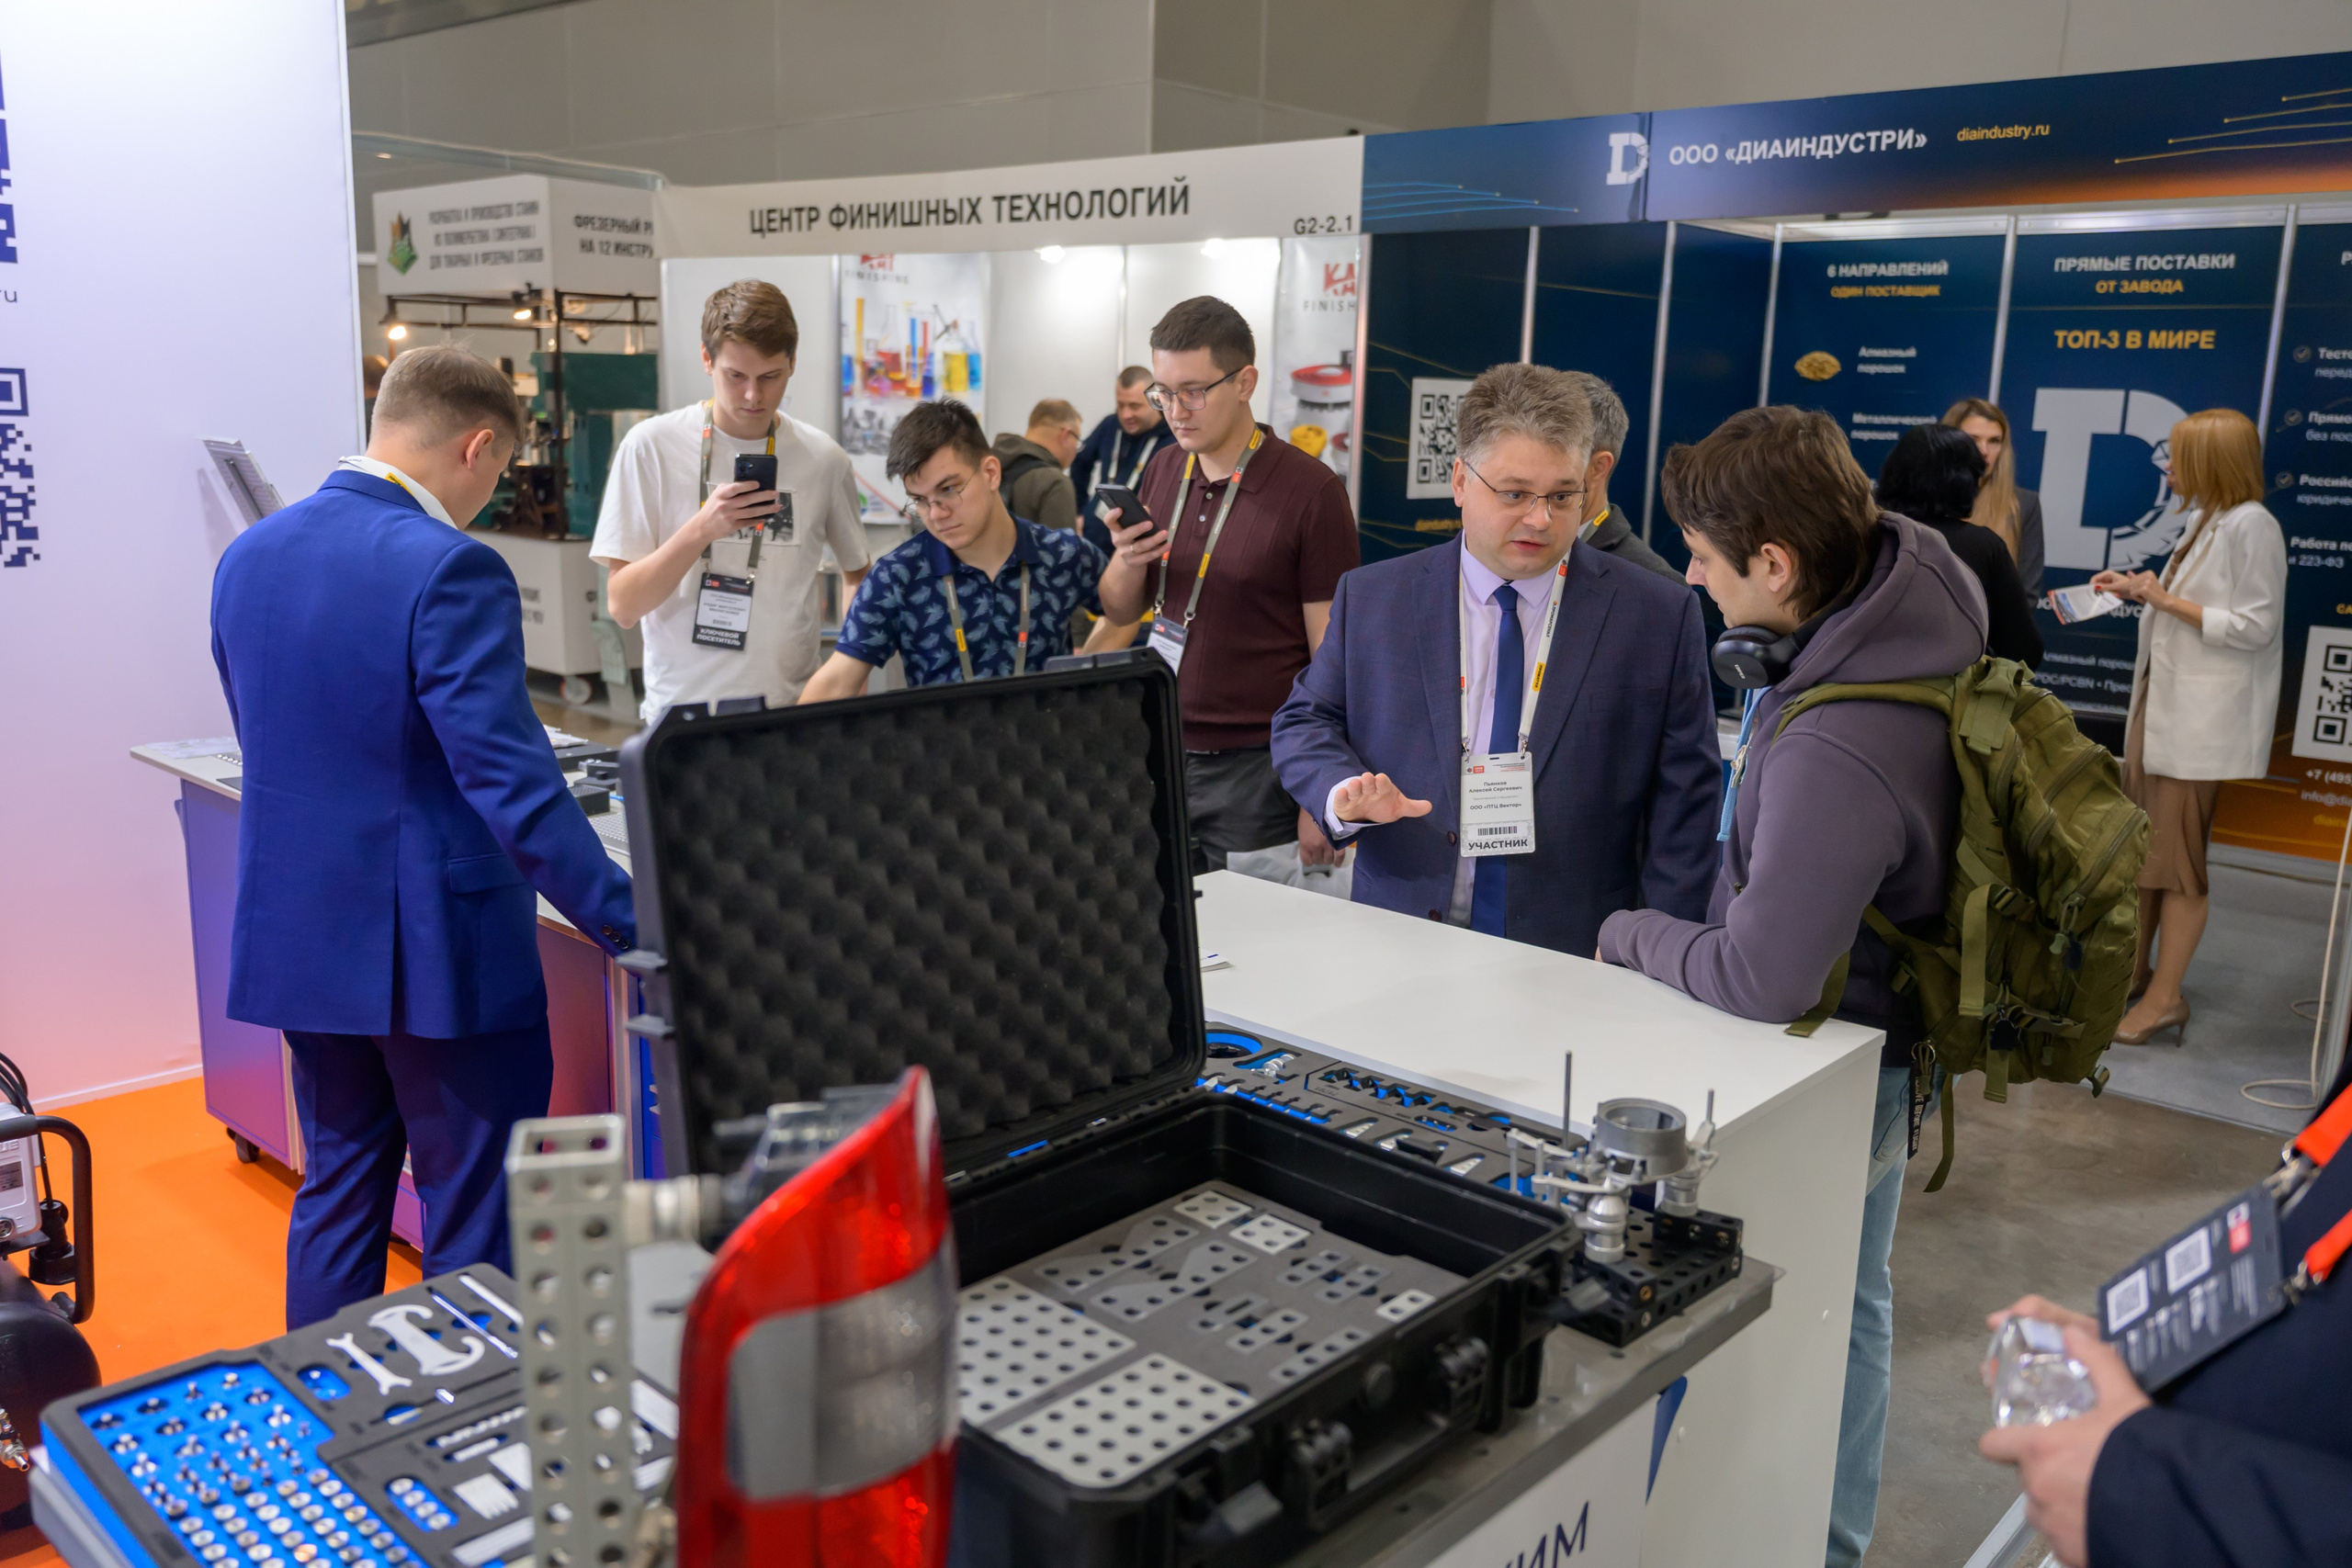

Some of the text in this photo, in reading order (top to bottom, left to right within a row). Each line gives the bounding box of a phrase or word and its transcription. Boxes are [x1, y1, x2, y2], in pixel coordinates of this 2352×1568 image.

[1956, 123, 2051, 142] diaindustry.ru
[1668, 128, 1928, 166] ООО «ДИАИНДУСТРИ»
[750, 175, 1190, 238] ЦЕНТР ФИНИШНЫХ ТЕХНОЛОГИЙ
[573, 214, 640, 232] ФРЕЗЕРНЫЙ
[1294, 215, 1352, 235] G2-2.1
[579, 239, 595, 255] НА
[1838, 259, 1950, 277] НАПРАВЛЕНИЙ
[2053, 253, 2236, 273] ПРЯМЫЕ ПОСТАВКИ
[1865, 284, 1940, 299] ПОСТАВЩИК
[2095, 278, 2185, 295] ОТ ЗАВОДА
[2053, 329, 2216, 349] ТОП-3 В МИРЕ
[2290, 536, 2337, 551] Работа
[2299, 554, 2345, 569] 223-ФЗ
[696, 634, 741, 646] ПОСЕТИТЕЛЬ
[700, 628, 739, 638] КЛЮЧЕВОЙ
[1468, 839, 1529, 851] УЧАСТНИК
